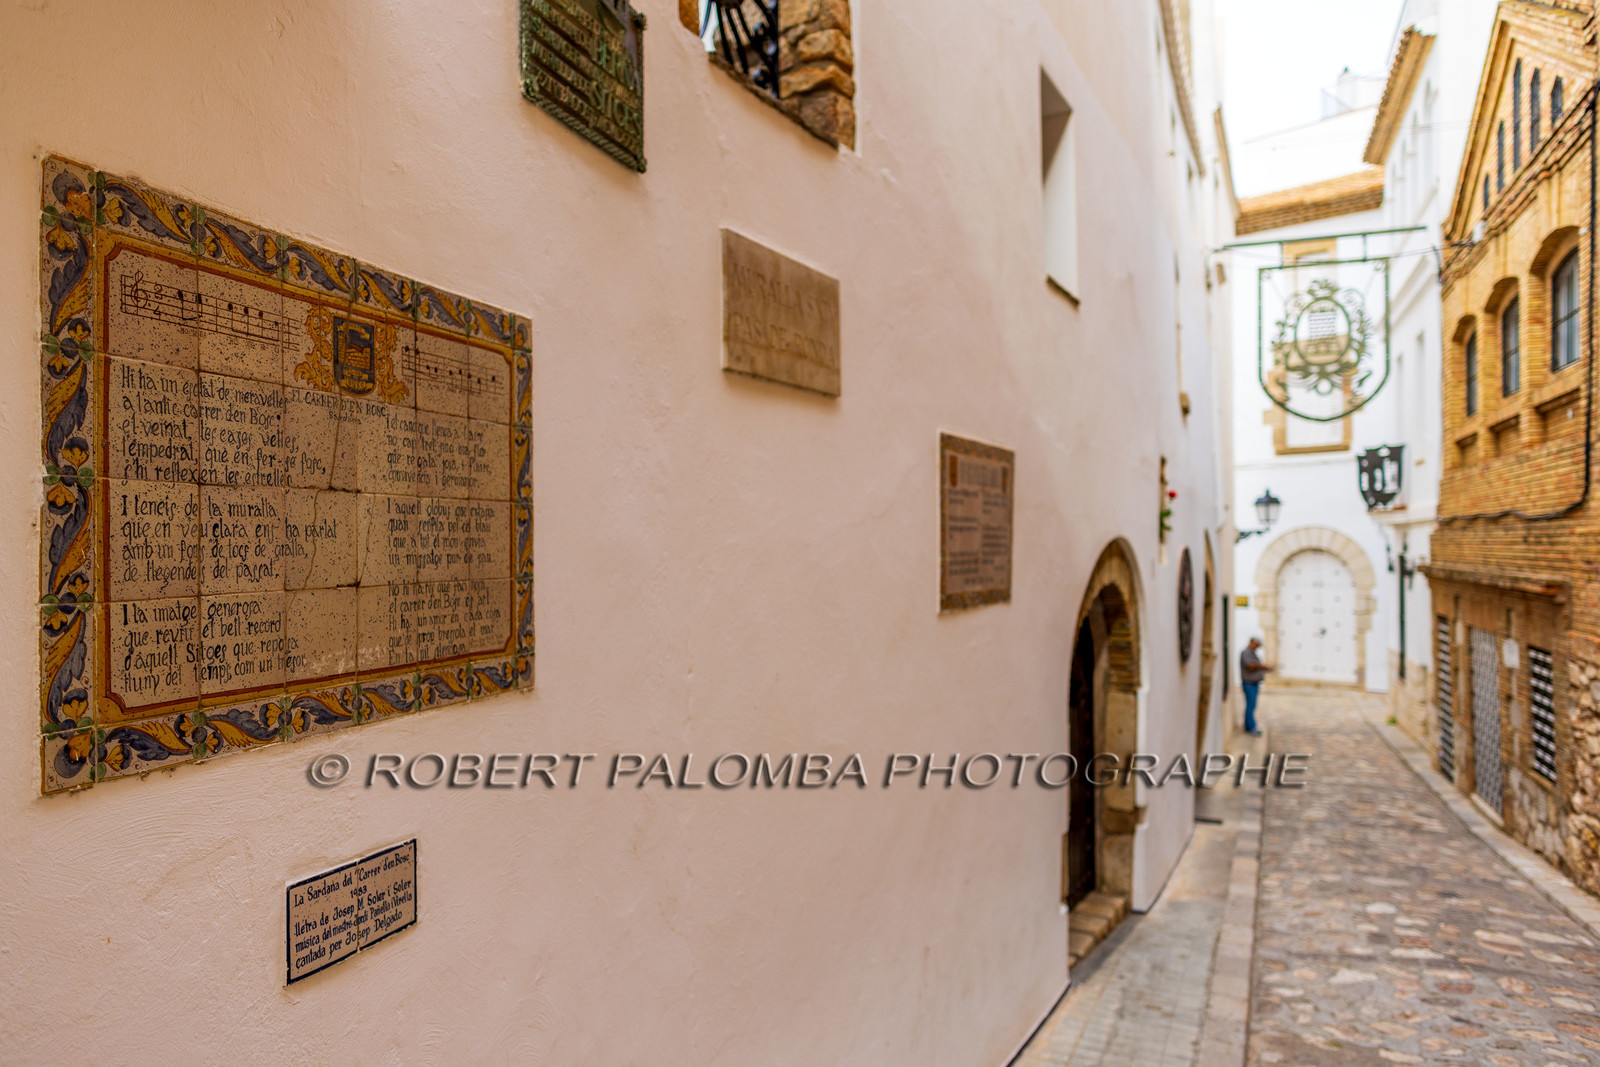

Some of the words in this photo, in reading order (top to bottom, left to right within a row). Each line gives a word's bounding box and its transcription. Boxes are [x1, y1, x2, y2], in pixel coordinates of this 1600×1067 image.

[122, 365, 134, 388] Hi
[139, 369, 157, 389] ha
[161, 378, 177, 393] un
[218, 379, 230, 400] de
[123, 396, 133, 412] a
[305, 392, 339, 408] CARRER
[122, 413, 137, 435] el
[205, 449, 228, 467] que
[234, 451, 249, 464] en
[121, 495, 127, 516] I
[185, 493, 198, 517] de
[208, 496, 222, 516] la
[228, 497, 277, 518] muralla
[387, 498, 391, 513] I
[395, 499, 421, 519] aquell
[121, 521, 149, 543] que
[156, 521, 171, 538] en
[181, 523, 207, 538] veu
[213, 518, 247, 538] clara
[285, 519, 300, 536] ha
[305, 519, 337, 539] parlat
[388, 519, 408, 536] quan
[122, 541, 153, 561] amb
[158, 544, 173, 559] un
[211, 539, 224, 558] de
[255, 540, 266, 557] de
[393, 536, 406, 551] que
[433, 533, 439, 549] el
[124, 561, 137, 582] de
[213, 559, 228, 579] del
[123, 604, 128, 625] I
[133, 603, 148, 623] la
[154, 600, 197, 627] imatge
[389, 598, 396, 613] el
[451, 613, 458, 623] en
[124, 631, 148, 654] que
[203, 619, 214, 638] el
[220, 618, 241, 637] bell
[248, 613, 281, 635] record
[389, 636, 402, 648] que
[470, 623, 475, 636] el
[234, 641, 253, 656] que
[124, 669, 159, 695] lluny
[166, 663, 182, 686] del
[234, 661, 254, 676] com
[260, 657, 272, 672] un
[294, 894, 304, 907] La
[307, 880, 339, 901] Sardana
[343, 873, 352, 886] del
[296, 919, 317, 937] lletra
[320, 912, 329, 926] de
[333, 905, 354, 920] Josep
[367, 890, 385, 906] Soler
[388, 886, 390, 897] i
[393, 880, 411, 895] Soler
[296, 945, 325, 969] cantada
[329, 940, 342, 960] per
[345, 927, 371, 945] Josep
[374, 909, 402, 932] Delgado
[322, 929, 331, 941] del
